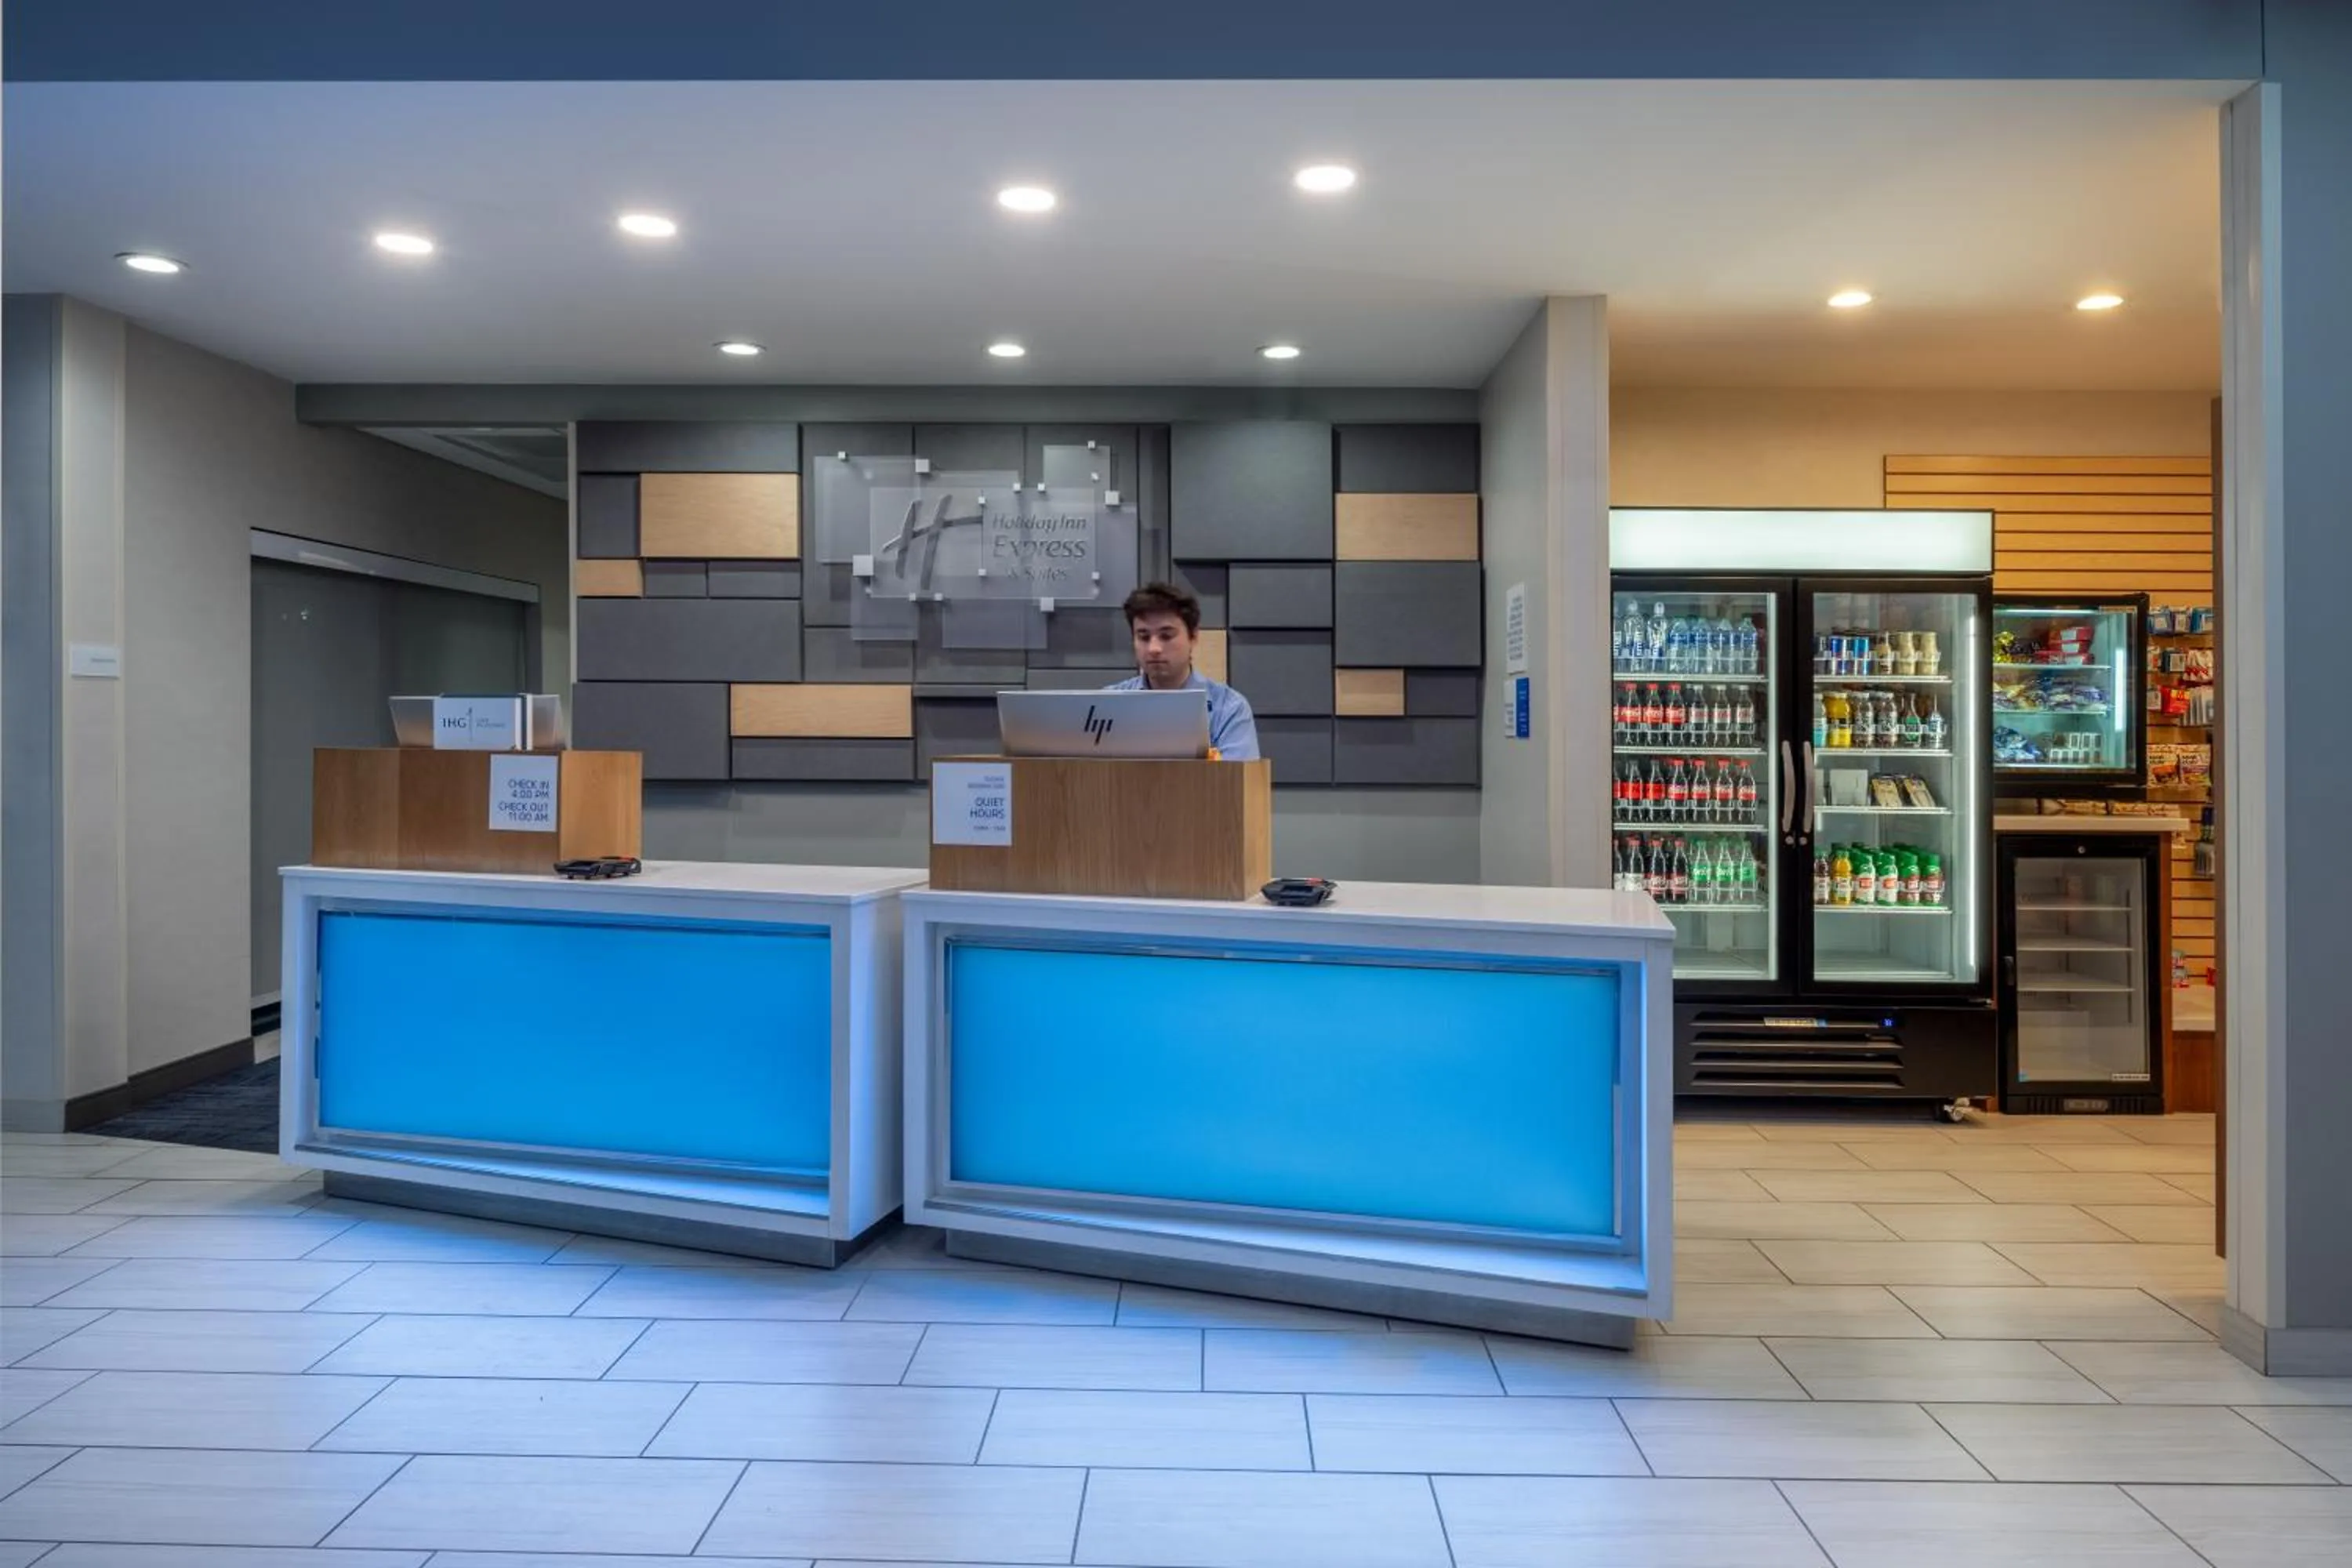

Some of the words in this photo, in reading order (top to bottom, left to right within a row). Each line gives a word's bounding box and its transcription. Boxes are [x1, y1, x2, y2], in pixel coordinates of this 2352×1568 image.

[993, 535, 1087, 558] Express
[442, 717, 467, 728] IHG
[1083, 705, 1113, 746] hp
[507, 779, 538, 789] CHECK
[539, 780, 550, 789] IN
[535, 789, 550, 798] PM
[498, 800, 528, 811] CHECK
[529, 802, 549, 812] OUT
[975, 797, 1004, 807] QUIET
[534, 812, 549, 822] AM
[970, 808, 1006, 819] HOURS
